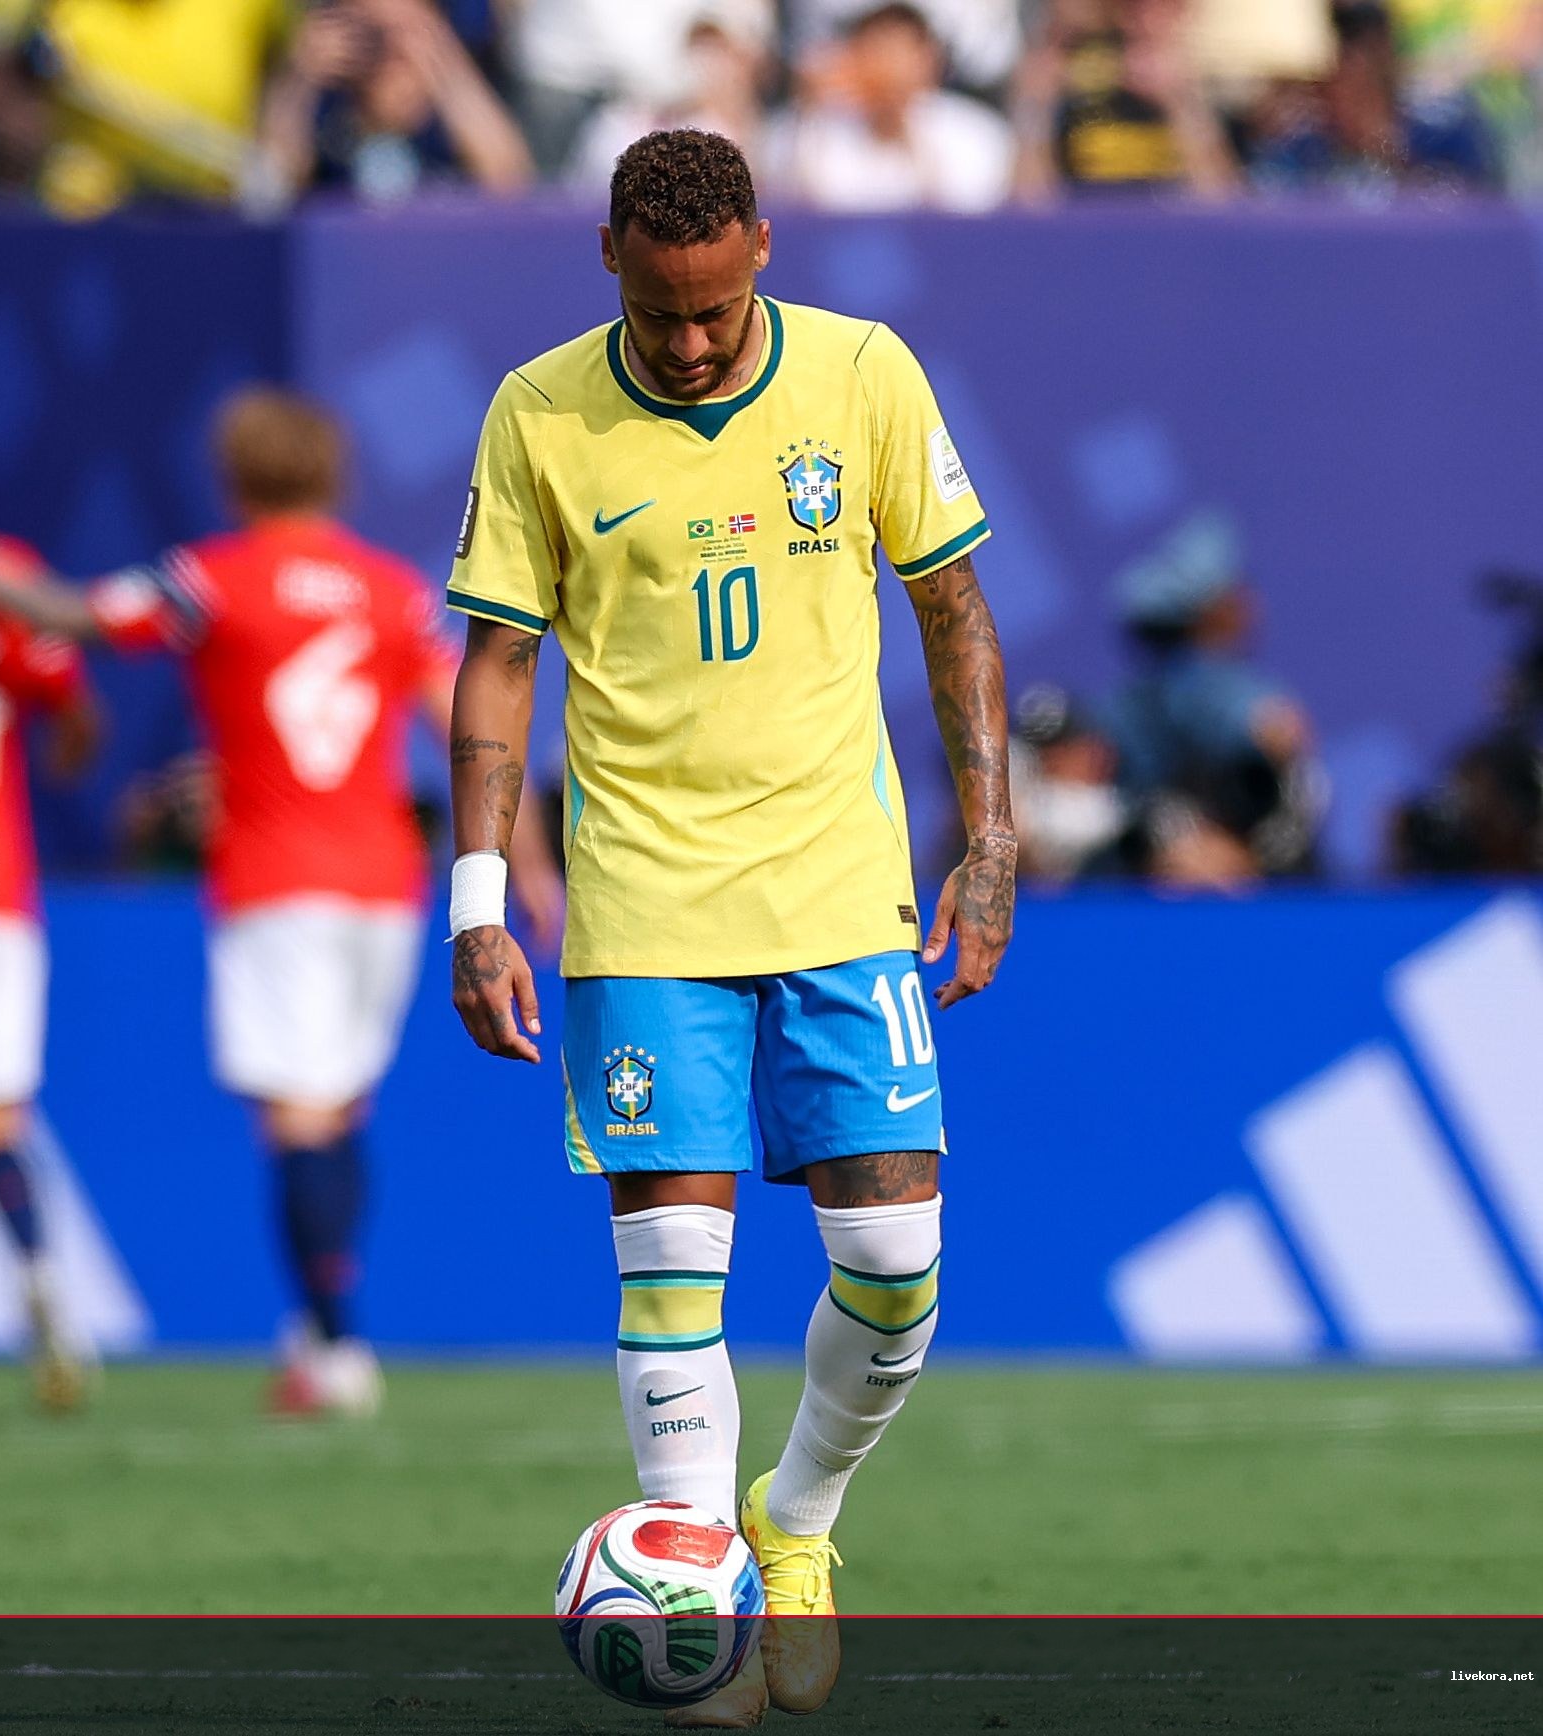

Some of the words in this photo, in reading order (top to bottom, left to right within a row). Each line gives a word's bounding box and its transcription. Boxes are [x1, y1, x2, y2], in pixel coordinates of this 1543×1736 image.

[803, 485, 825, 496] CBF
[788, 538, 841, 556] BRASIL
[692, 566, 760, 662] 10
[263, 618, 381, 792] 6
[871, 971, 934, 1067] 10
[619, 1082, 637, 1091] CBF
[606, 1122, 659, 1137] BRASIL
[651, 1416, 711, 1437] BRASIL
